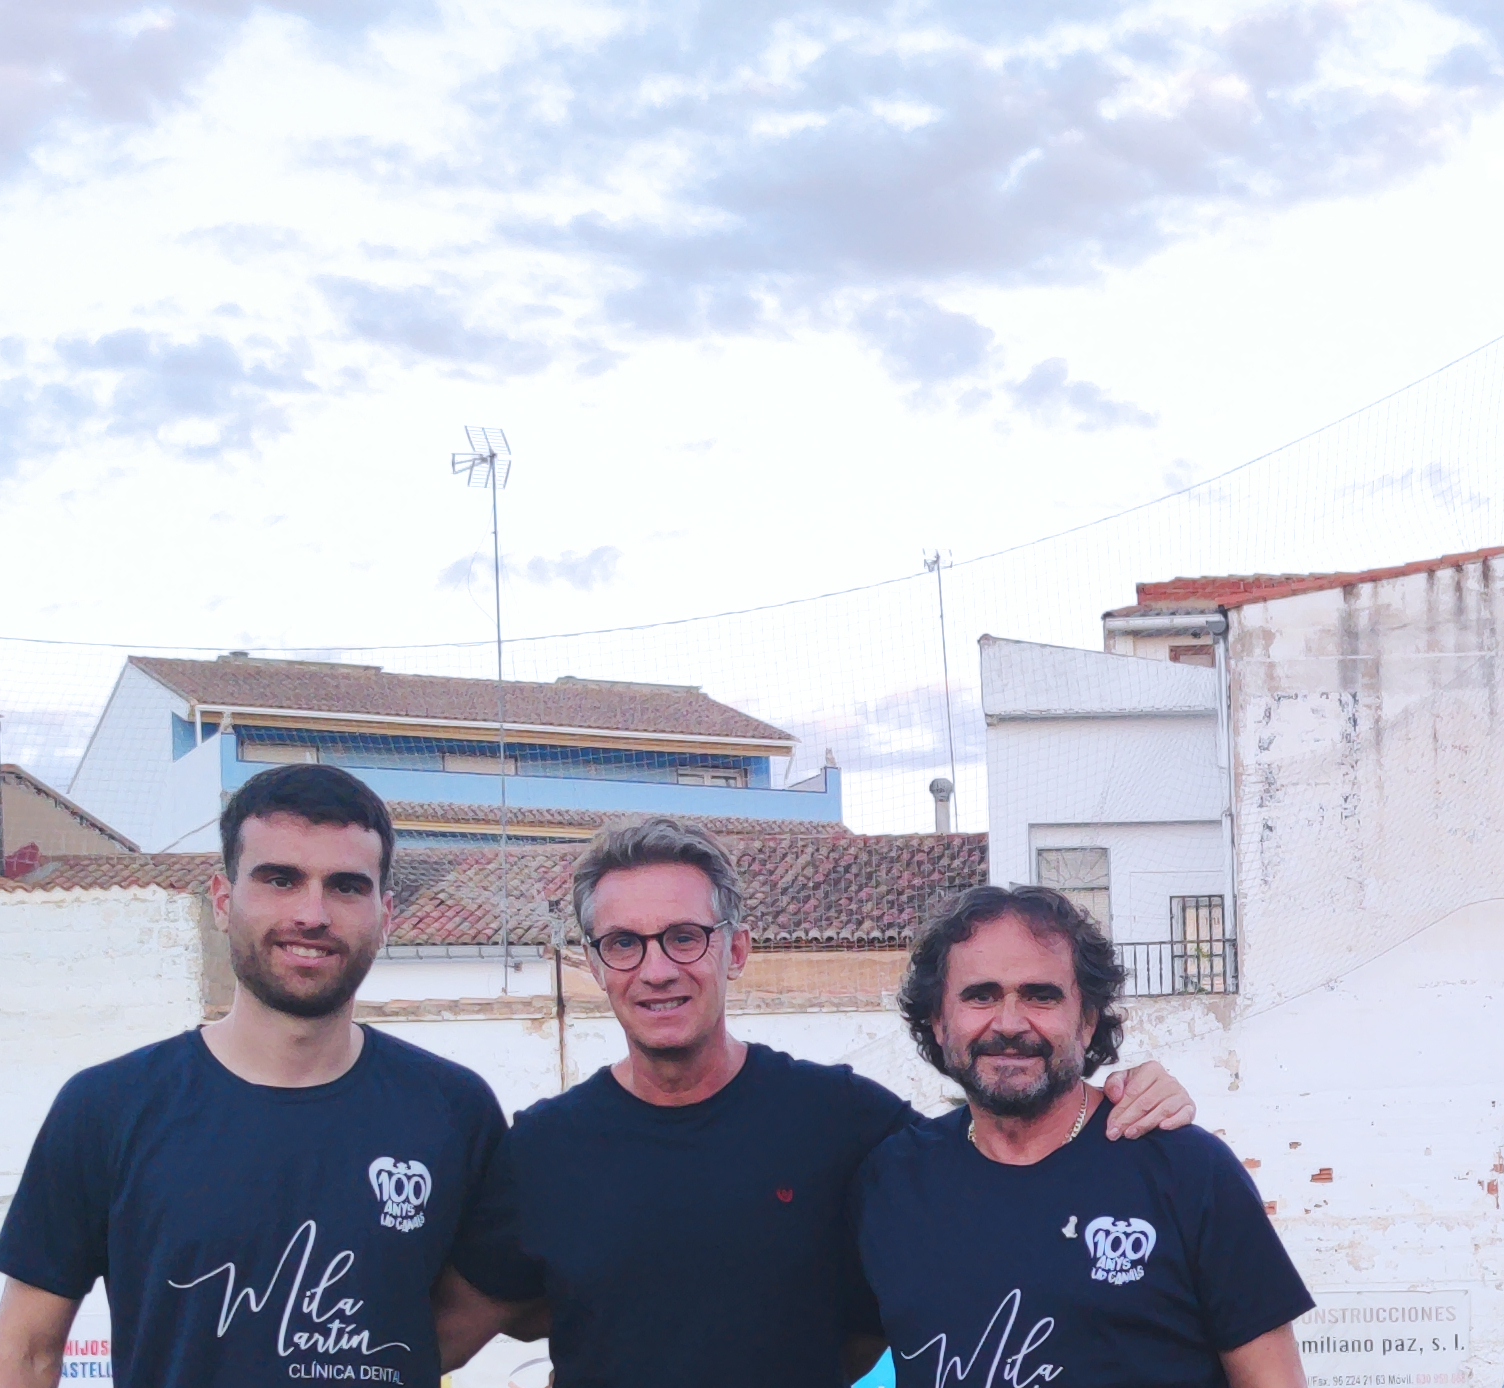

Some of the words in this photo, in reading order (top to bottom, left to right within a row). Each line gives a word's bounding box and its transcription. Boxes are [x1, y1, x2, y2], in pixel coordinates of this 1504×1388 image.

[378, 1171, 426, 1206] 100
[384, 1199, 415, 1216] ANYS
[1093, 1230, 1148, 1260] 100
[1096, 1255, 1131, 1271] ANYS
[1382, 1338, 1424, 1356] paz,
[289, 1360, 356, 1380] CLÍNICA
[360, 1366, 405, 1386] DENTAL
[1346, 1375, 1361, 1386] 224
